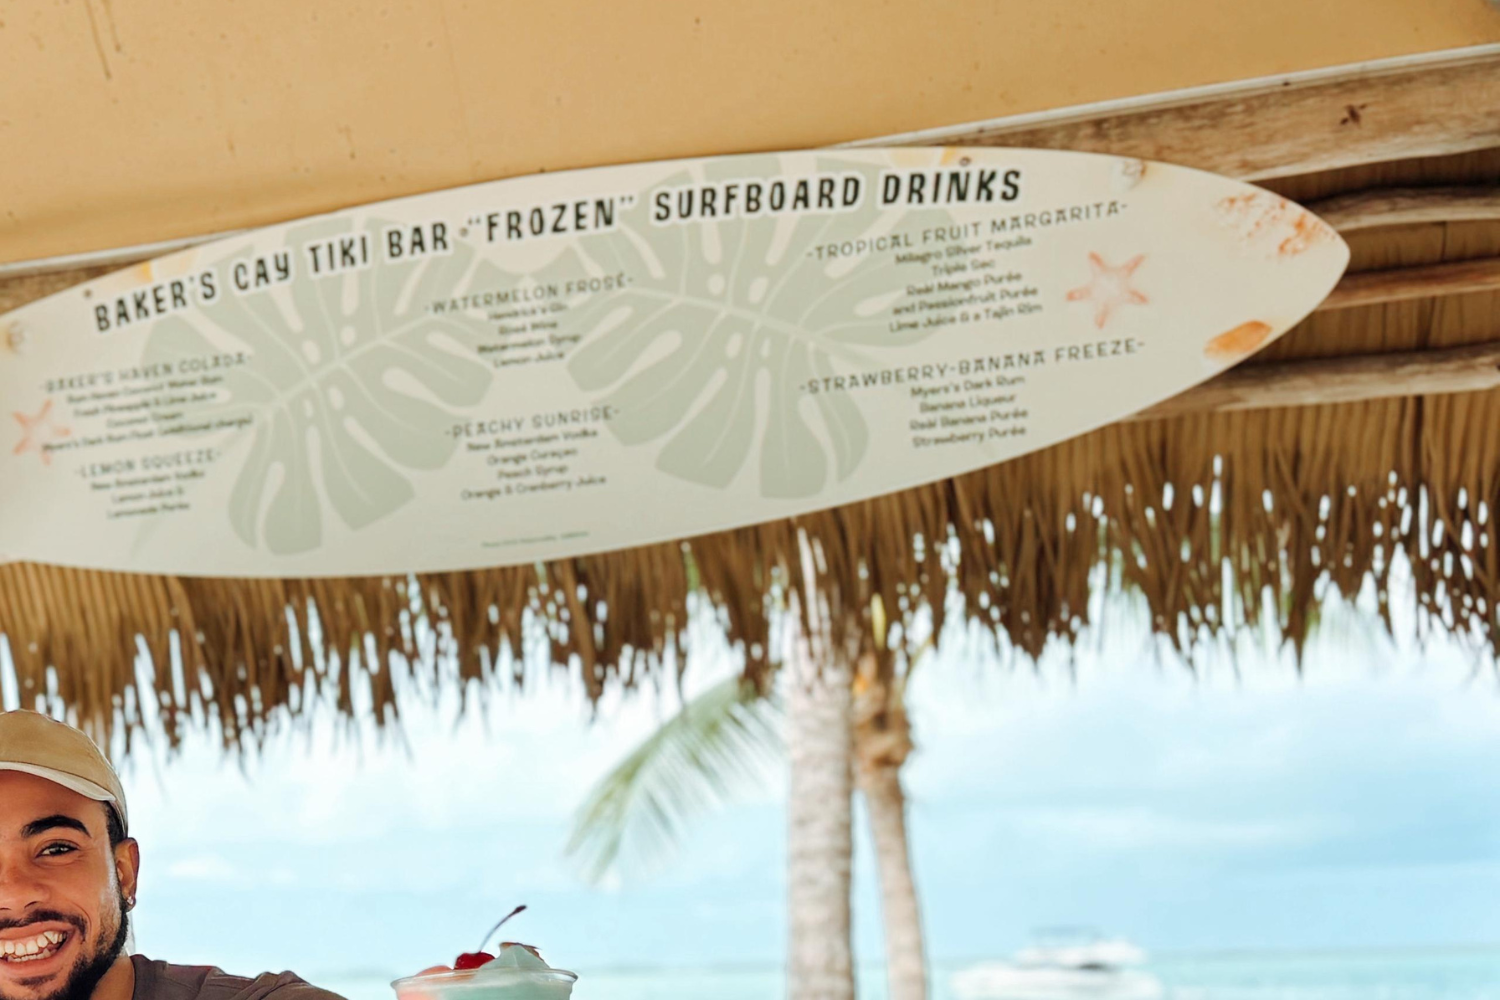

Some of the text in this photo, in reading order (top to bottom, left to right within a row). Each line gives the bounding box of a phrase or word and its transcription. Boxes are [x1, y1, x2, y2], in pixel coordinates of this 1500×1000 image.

[94, 271, 217, 333] BAKER'S
[234, 251, 291, 292] CAY
[308, 235, 368, 274] TIKI
[387, 221, 449, 258] BAR
[654, 175, 861, 223] SURFBOARD
[883, 168, 1022, 206] DRINKS
[922, 222, 982, 244] FRUIT
